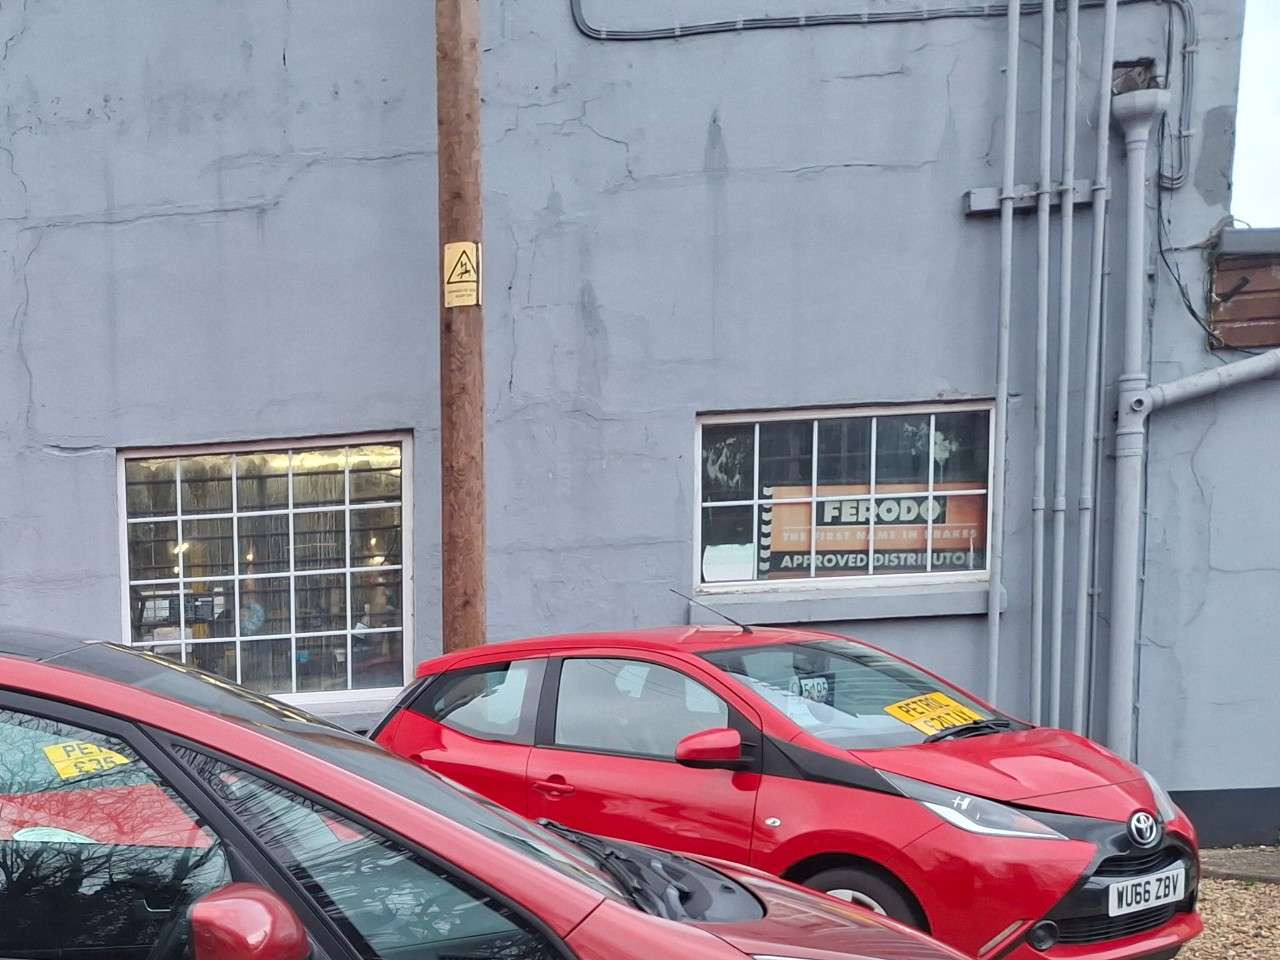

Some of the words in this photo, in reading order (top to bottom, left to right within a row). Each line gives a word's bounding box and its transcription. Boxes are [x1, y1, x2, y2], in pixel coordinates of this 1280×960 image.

[823, 499, 941, 522] FERODO
[780, 553, 868, 569] APPROVED
[1116, 881, 1151, 909] WU66
[1155, 874, 1179, 901] ZBV
